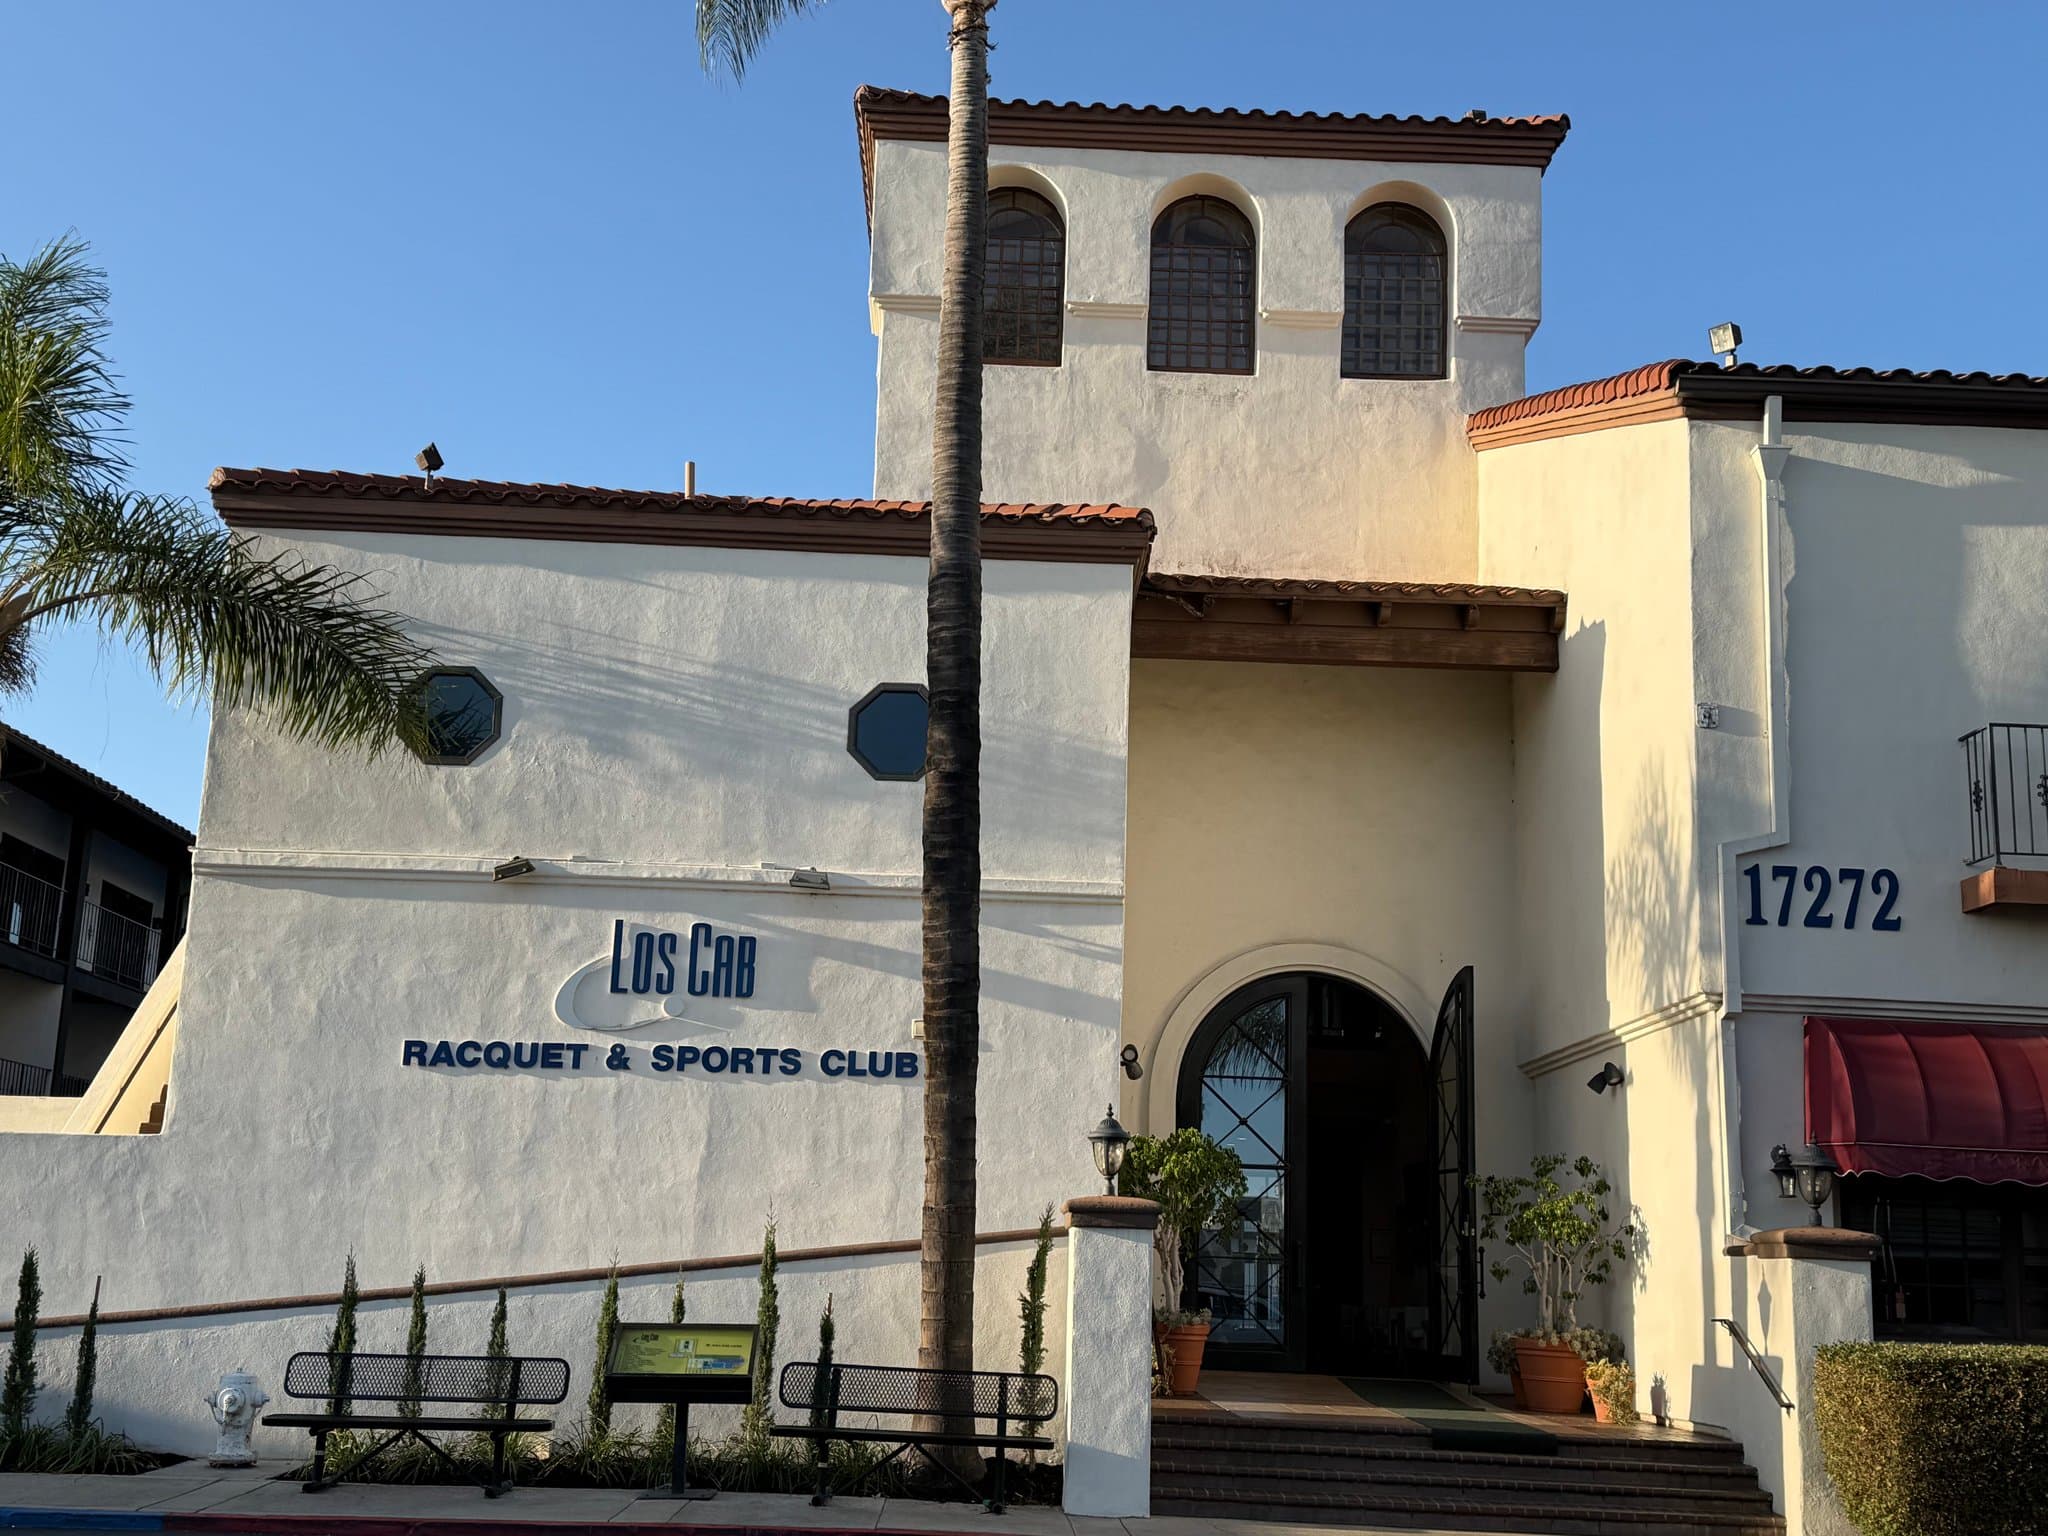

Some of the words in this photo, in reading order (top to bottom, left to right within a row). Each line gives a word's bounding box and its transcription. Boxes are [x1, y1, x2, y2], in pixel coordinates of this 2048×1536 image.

[1743, 863, 1902, 932] 17272
[610, 919, 678, 995] LOS
[688, 922, 757, 998] CAB
[402, 1039, 589, 1070] RACQUET
[605, 1043, 631, 1071] &
[651, 1044, 802, 1076] SPORTS
[820, 1049, 919, 1078] CLUB
